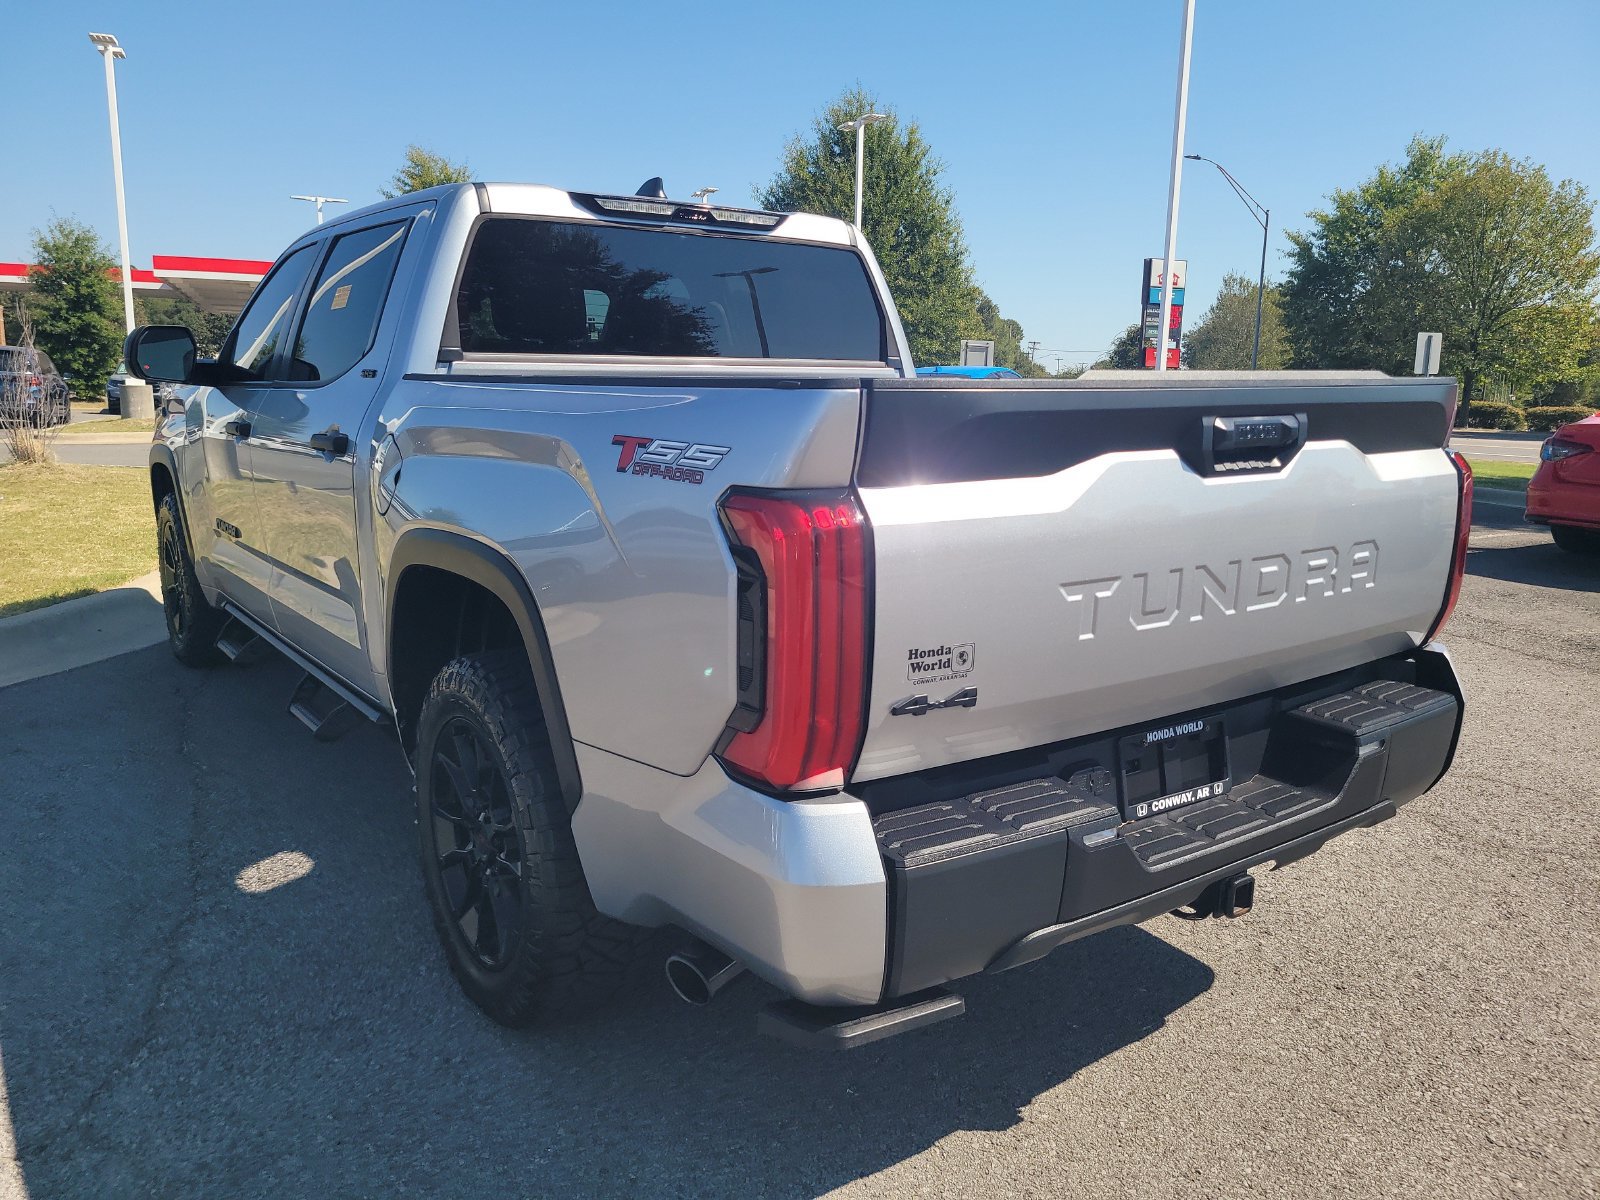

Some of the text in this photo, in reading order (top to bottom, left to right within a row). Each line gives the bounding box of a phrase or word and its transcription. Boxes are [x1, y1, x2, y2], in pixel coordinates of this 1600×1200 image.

[611, 434, 732, 473] TSS
[632, 461, 705, 485] OFF-ROAD
[1058, 538, 1380, 641] TUNDRA
[908, 645, 952, 660] Honda
[910, 658, 951, 673] World
[939, 673, 968, 682] ARKANSAS
[1146, 721, 1203, 742] HONDA WORLD
[1151, 787, 1210, 811] CONWAY, AR
